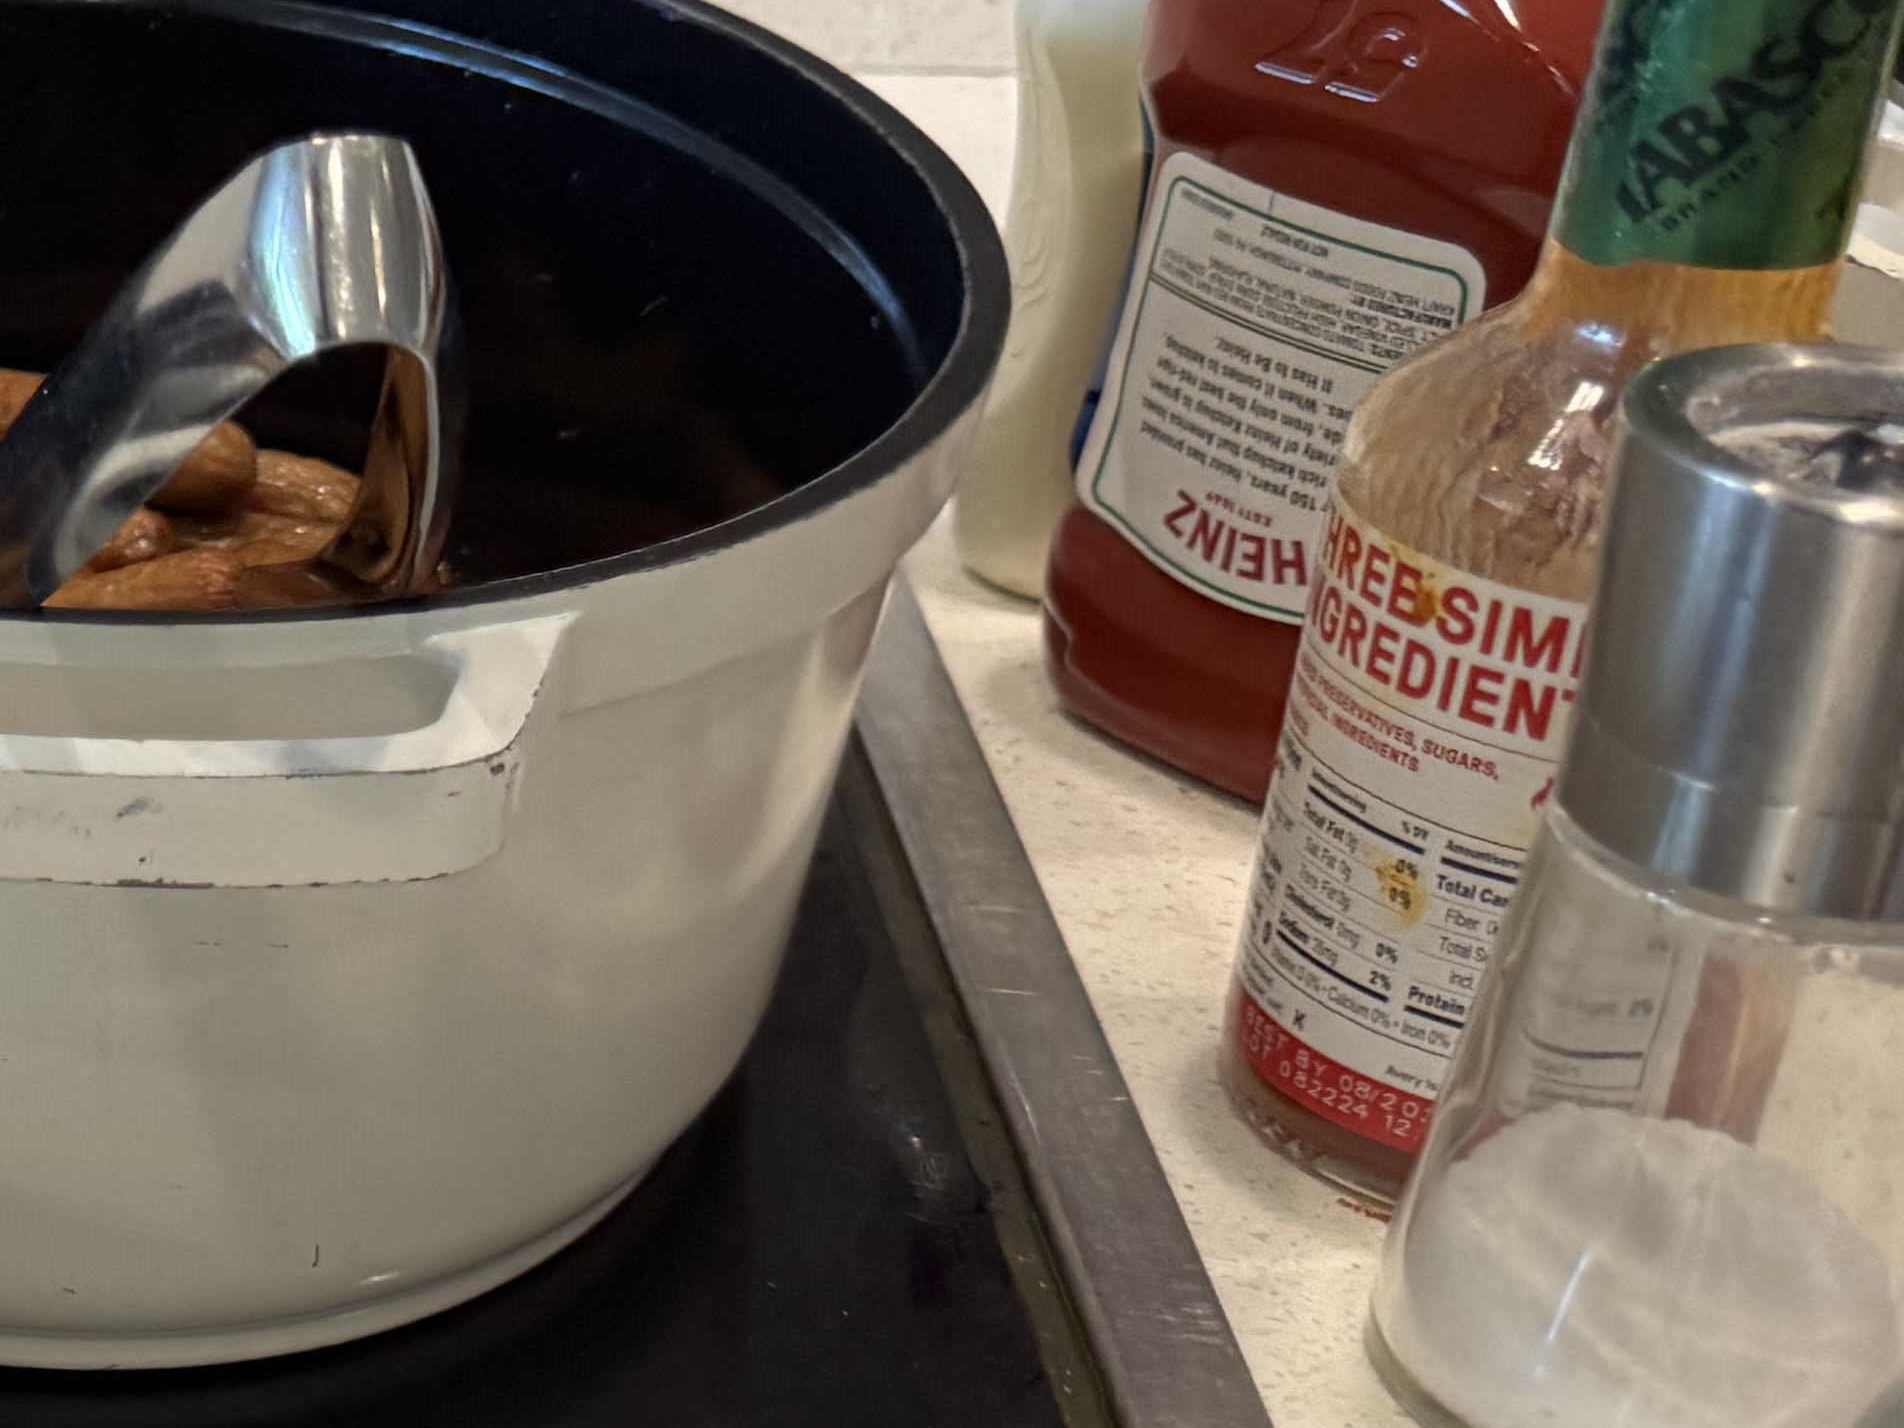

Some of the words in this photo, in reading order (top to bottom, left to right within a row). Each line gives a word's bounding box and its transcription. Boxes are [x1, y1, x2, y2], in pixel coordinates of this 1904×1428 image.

[1279, 389, 1317, 413] When
[1245, 424, 1281, 449] Heinz
[1283, 440, 1299, 453] of
[1303, 443, 1336, 466] riety
[1298, 470, 1327, 487] rich
[1290, 491, 1315, 511] 150
[1164, 490, 1307, 586] HEINZ
[1325, 512, 1432, 628] HREE
[1435, 587, 1587, 680] SIM
[1310, 574, 1577, 741] NGREDIEN
[1421, 739, 1499, 782] SUGARS,
[1437, 874, 1476, 899] Total
[1445, 908, 1480, 930] Fiber
[1375, 942, 1398, 964] 0%
[1440, 936, 1473, 959] Total
[1368, 969, 1392, 992] 2%
[1408, 986, 1465, 1015] Protein
[1401, 1020, 1426, 1041] Iron
[1294, 1049, 1329, 1077] BY
[1279, 1061, 1370, 1119] 082224
